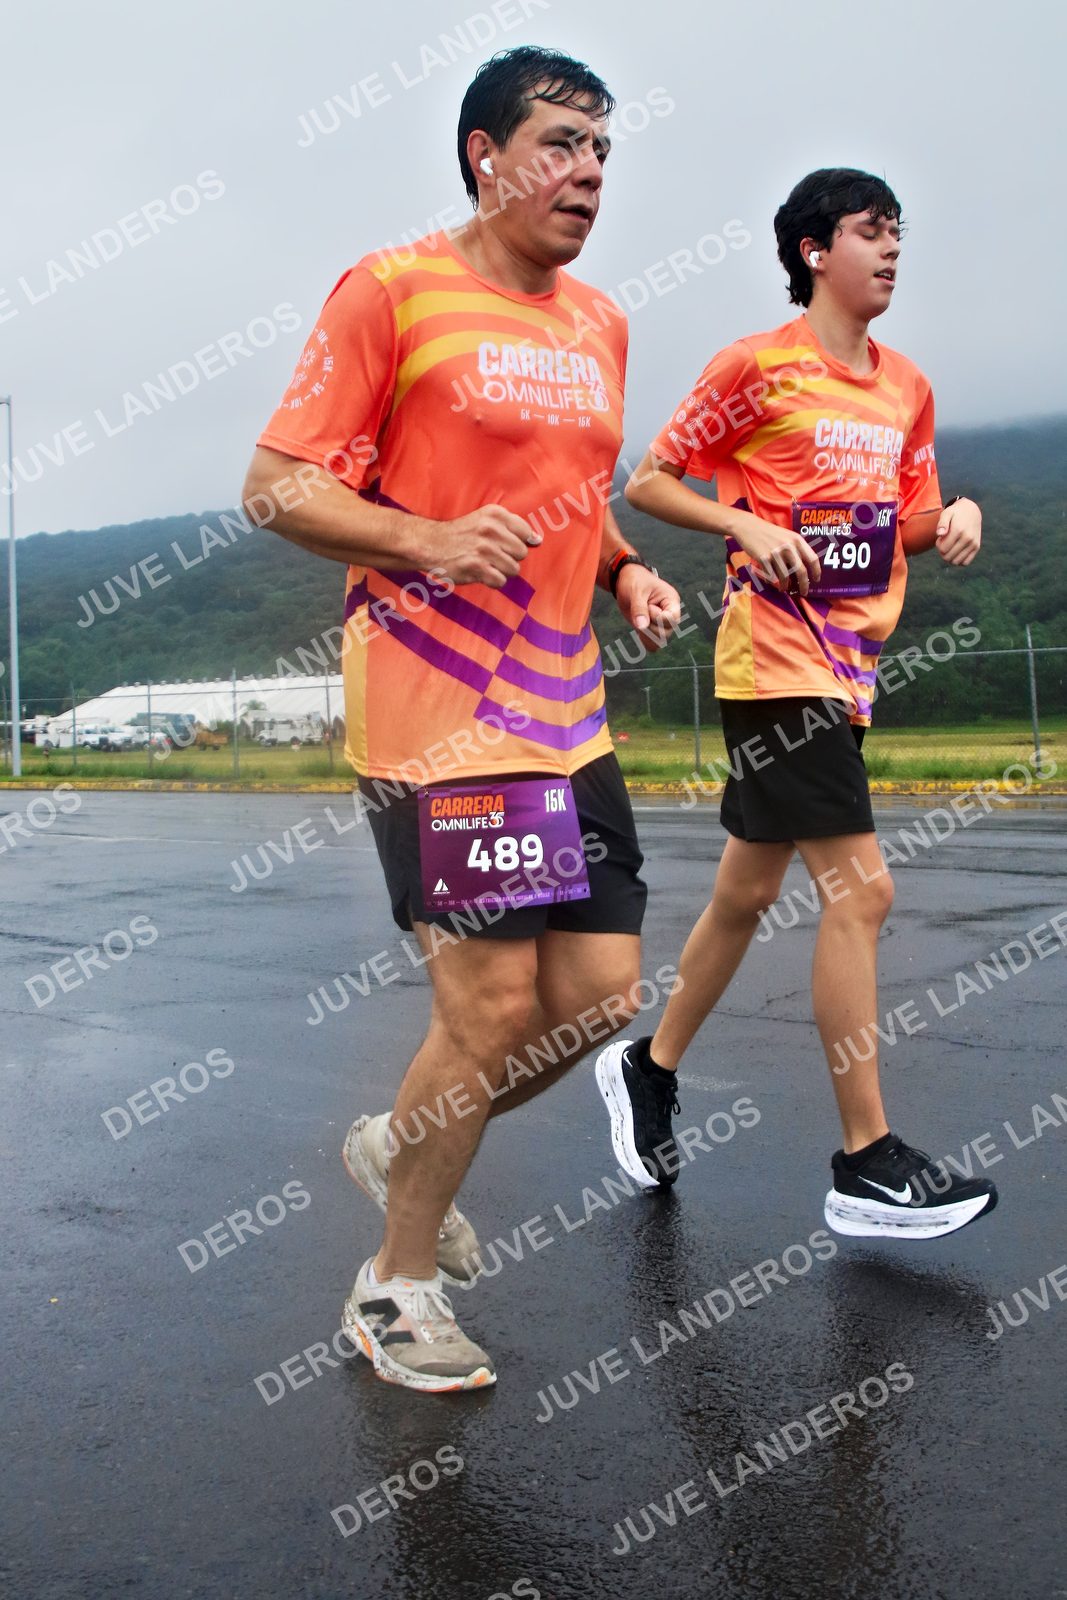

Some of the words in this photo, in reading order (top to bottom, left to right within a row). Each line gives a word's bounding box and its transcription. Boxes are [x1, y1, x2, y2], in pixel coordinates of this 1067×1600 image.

[477, 341, 604, 384] CARRERA
[815, 418, 904, 458] CARRERA
[801, 509, 853, 525] CARRERA
[877, 508, 892, 527] 15K
[823, 542, 871, 569] 490
[431, 794, 505, 817] CARRERA
[544, 788, 567, 812] 15K
[467, 834, 543, 872] 489
